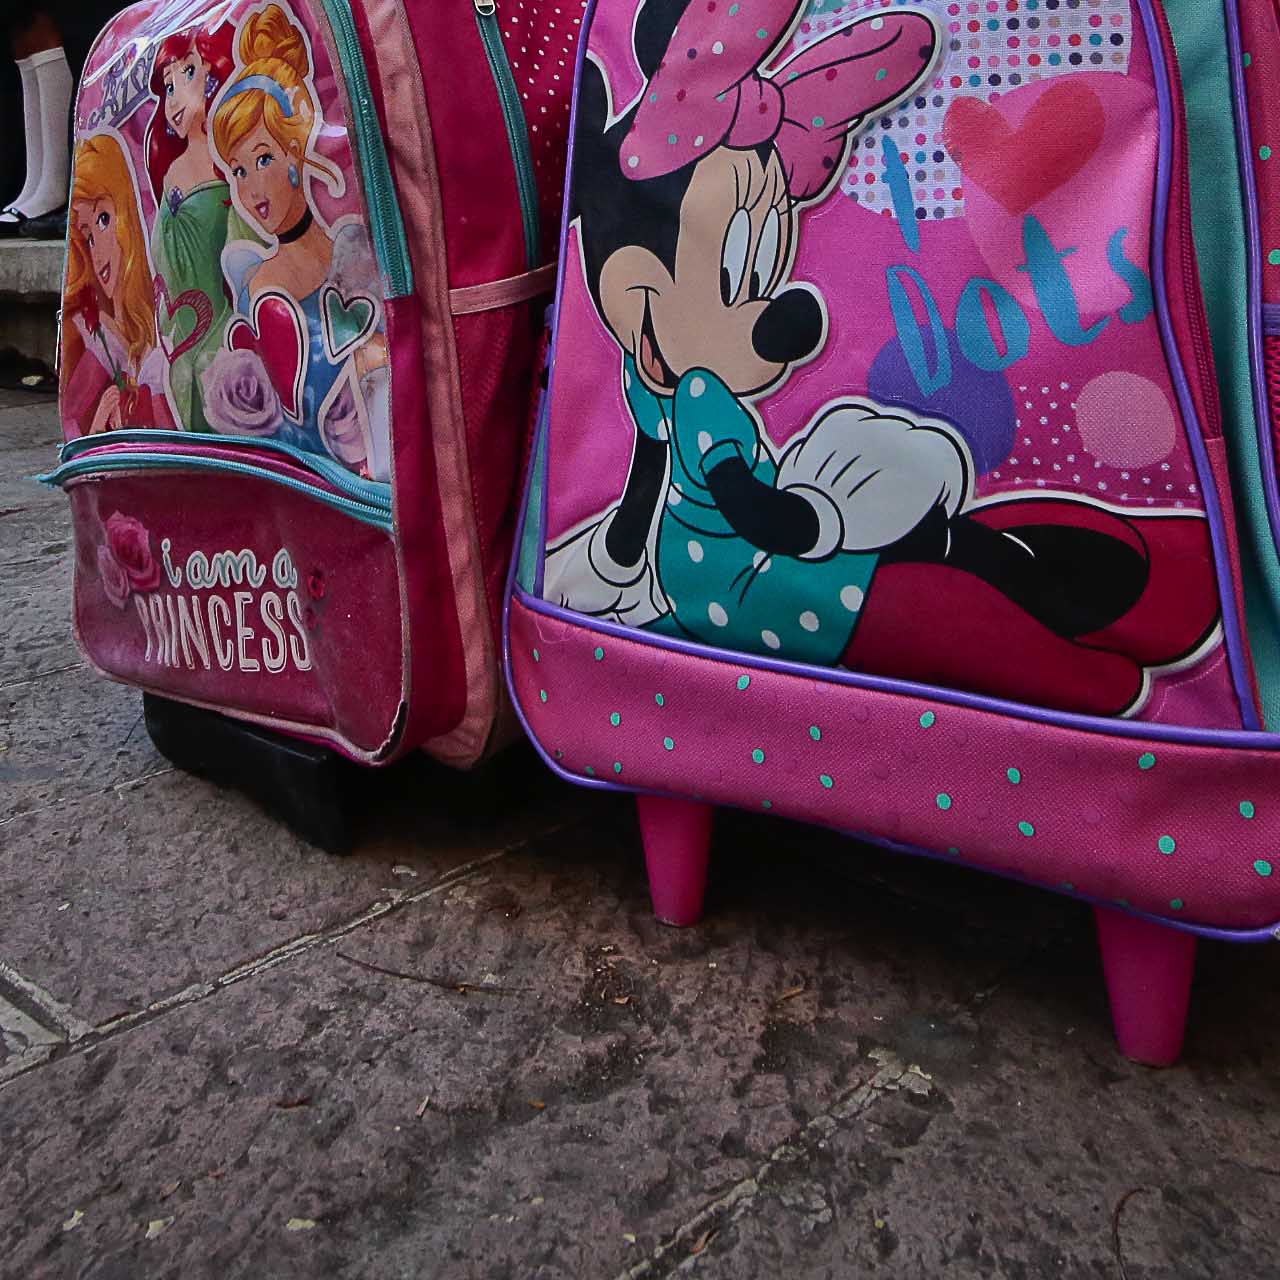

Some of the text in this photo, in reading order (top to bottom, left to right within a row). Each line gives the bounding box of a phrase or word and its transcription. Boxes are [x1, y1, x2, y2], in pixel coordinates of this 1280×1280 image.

[186, 548, 267, 590] am
[272, 547, 298, 589] a
[134, 590, 313, 673] PRINCESS
